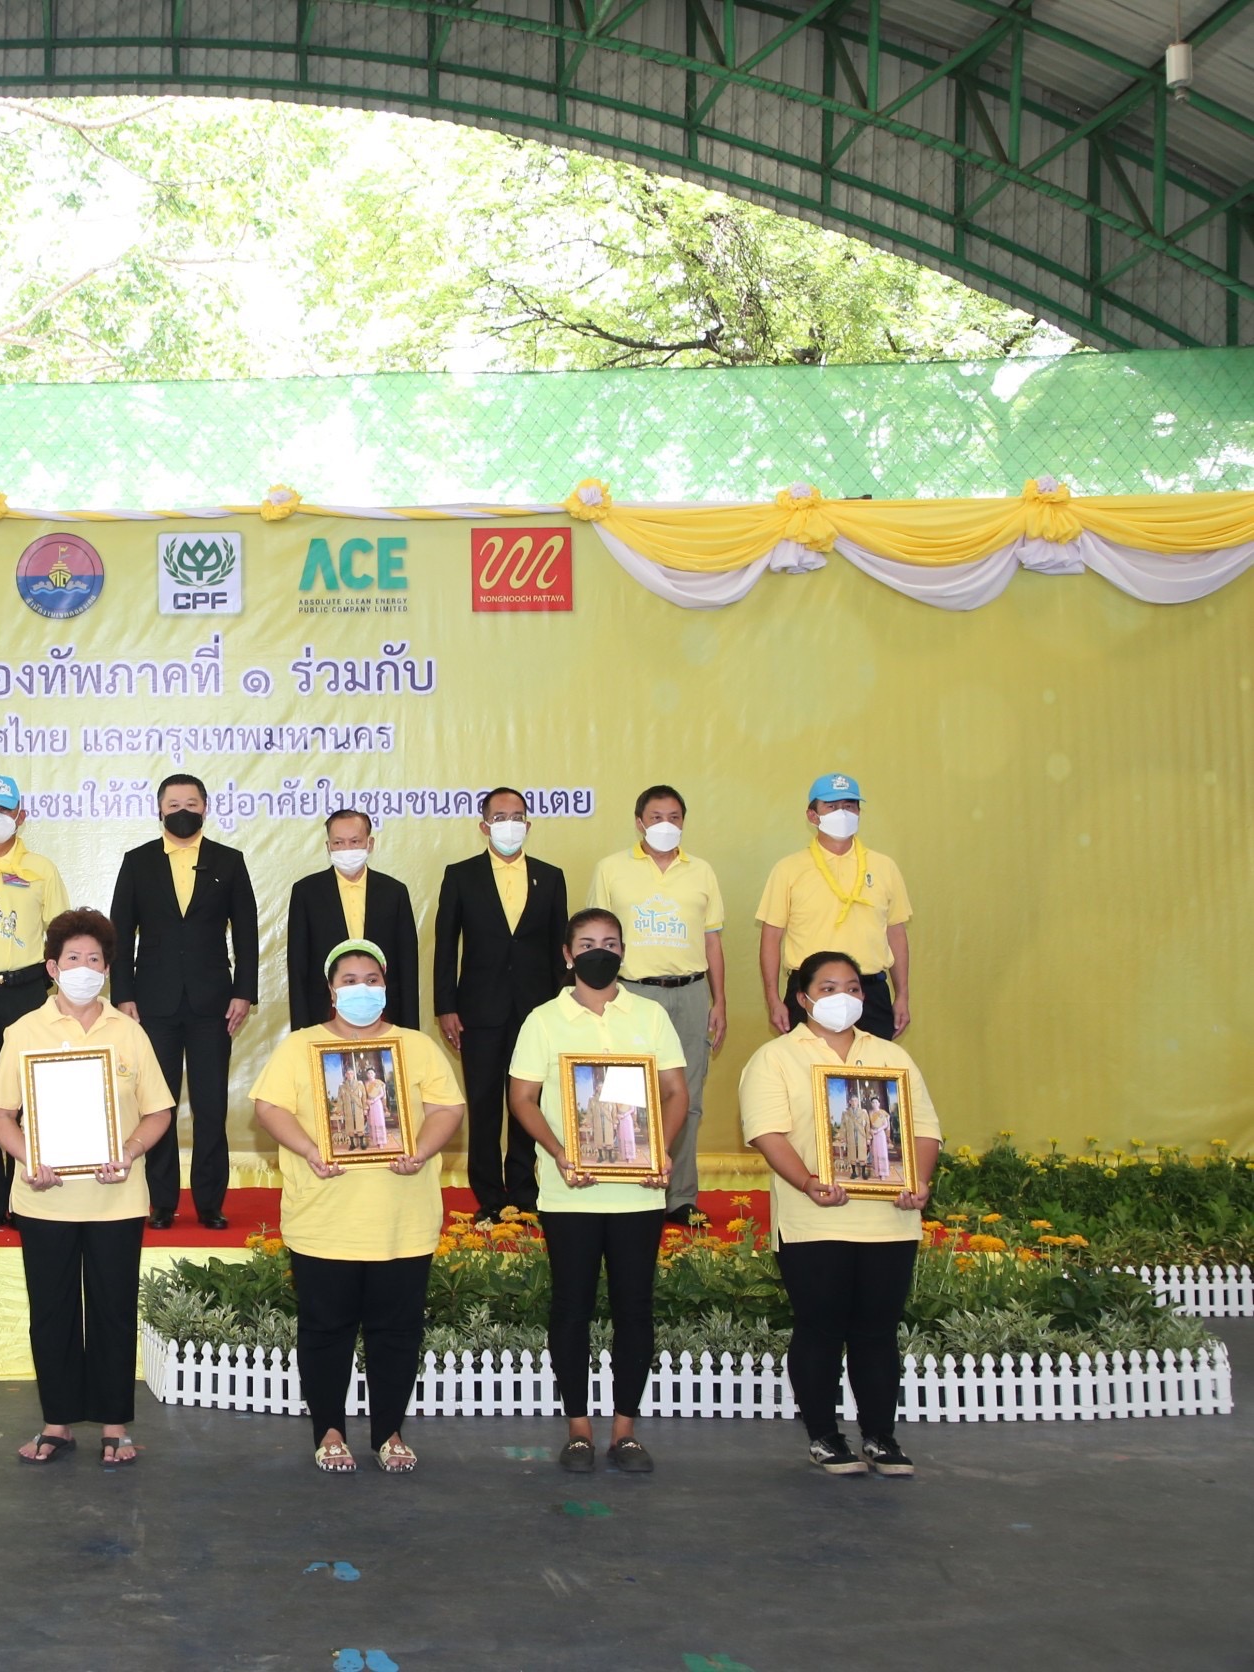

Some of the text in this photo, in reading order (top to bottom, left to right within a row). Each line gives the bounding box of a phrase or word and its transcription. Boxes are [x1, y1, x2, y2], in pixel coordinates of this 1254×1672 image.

[298, 537, 407, 591] ACE
[173, 592, 227, 610] CPF
[478, 594, 565, 603] NONGNOOCH PATTAYA
[242, 669, 270, 694] ๑
[291, 643, 434, 693] ร่วมกับ
[83, 723, 393, 762] และกรุงเทพมหานคร
